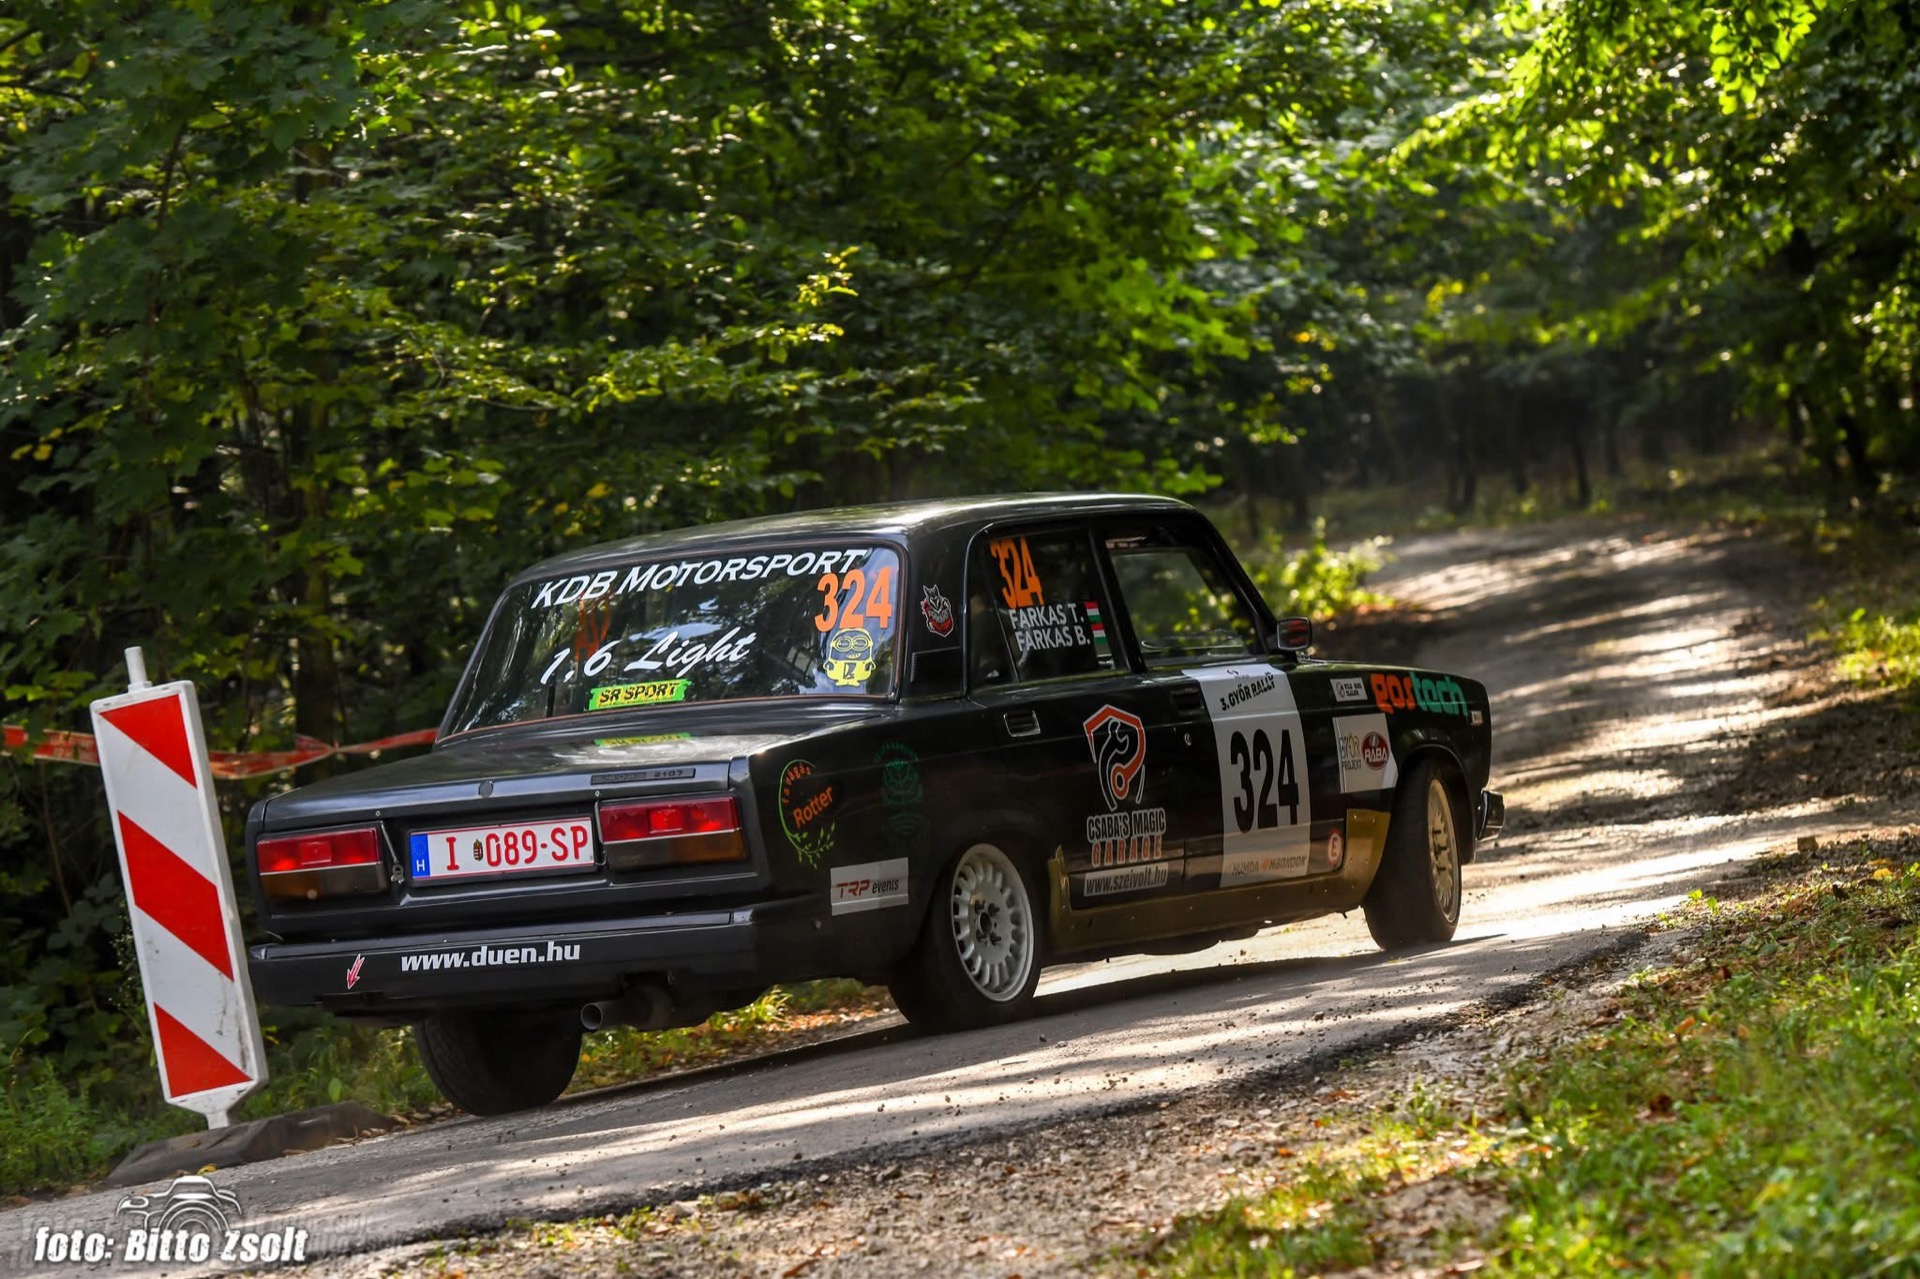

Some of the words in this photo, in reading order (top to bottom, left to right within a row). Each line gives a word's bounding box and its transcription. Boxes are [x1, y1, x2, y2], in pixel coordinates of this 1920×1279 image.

[531, 570, 618, 609] KDB
[616, 549, 868, 596] MOTORSPORT
[990, 534, 1044, 609] 324
[814, 567, 893, 632] 324
[1008, 607, 1067, 630] FARKAS
[1067, 603, 1084, 624] T.
[624, 626, 758, 678] Light
[1014, 628, 1073, 652] FARKAS
[1074, 625, 1091, 646] B.
[599, 688, 622, 704] SR
[623, 682, 681, 700] SPORT
[1250, 672, 1276, 698] RALLY
[654, 770, 684, 779] 2107
[1230, 728, 1300, 834] 324
[792, 786, 834, 830] Rotter
[1087, 811, 1131, 843] CSABA'S
[1131, 807, 1167, 839] MAGIC
[484, 825, 589, 868] 089-SP
[1092, 835, 1163, 868] GARAGE
[416, 858, 427, 873] H
[836, 879, 871, 898] TRP
[871, 877, 900, 894] events
[401, 941, 581, 972] www.duen.hu
